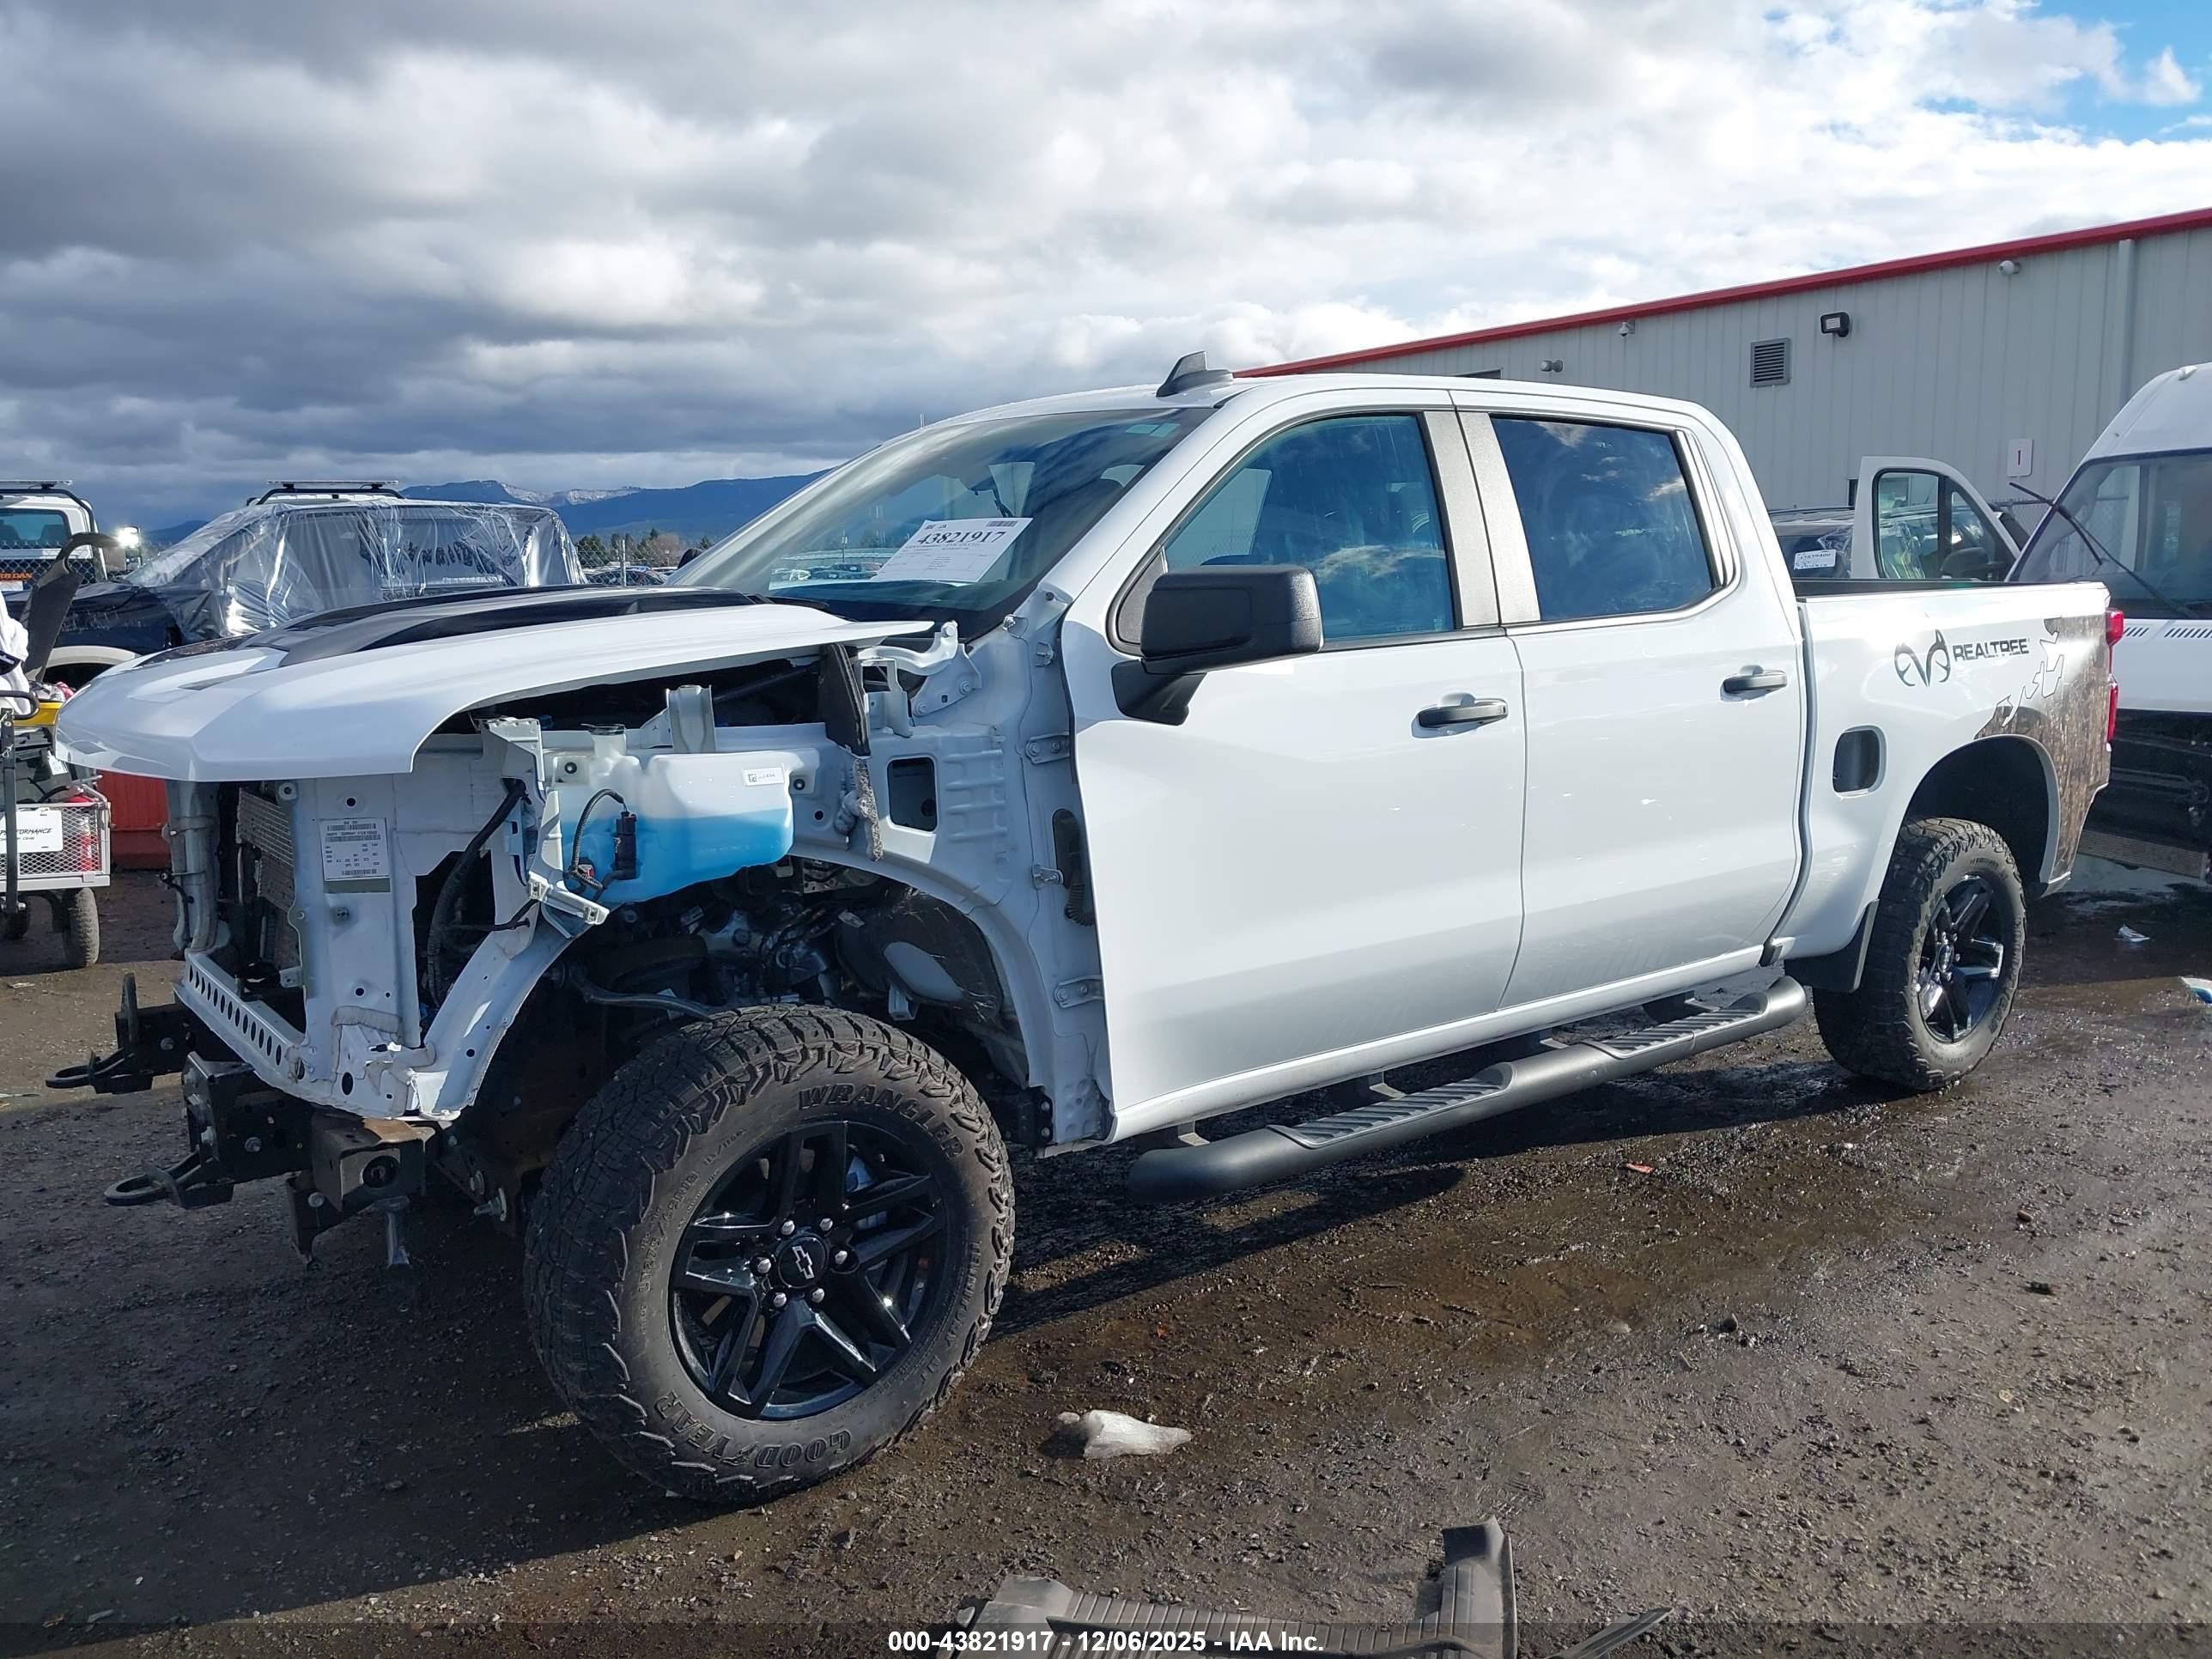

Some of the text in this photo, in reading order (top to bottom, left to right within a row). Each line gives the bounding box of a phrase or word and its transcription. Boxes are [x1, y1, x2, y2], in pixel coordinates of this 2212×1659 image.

[918, 532, 1006, 544] 43821917
[798, 1083, 963, 1158] WRANGLER
[654, 1390, 852, 1468] GOODYEAR
